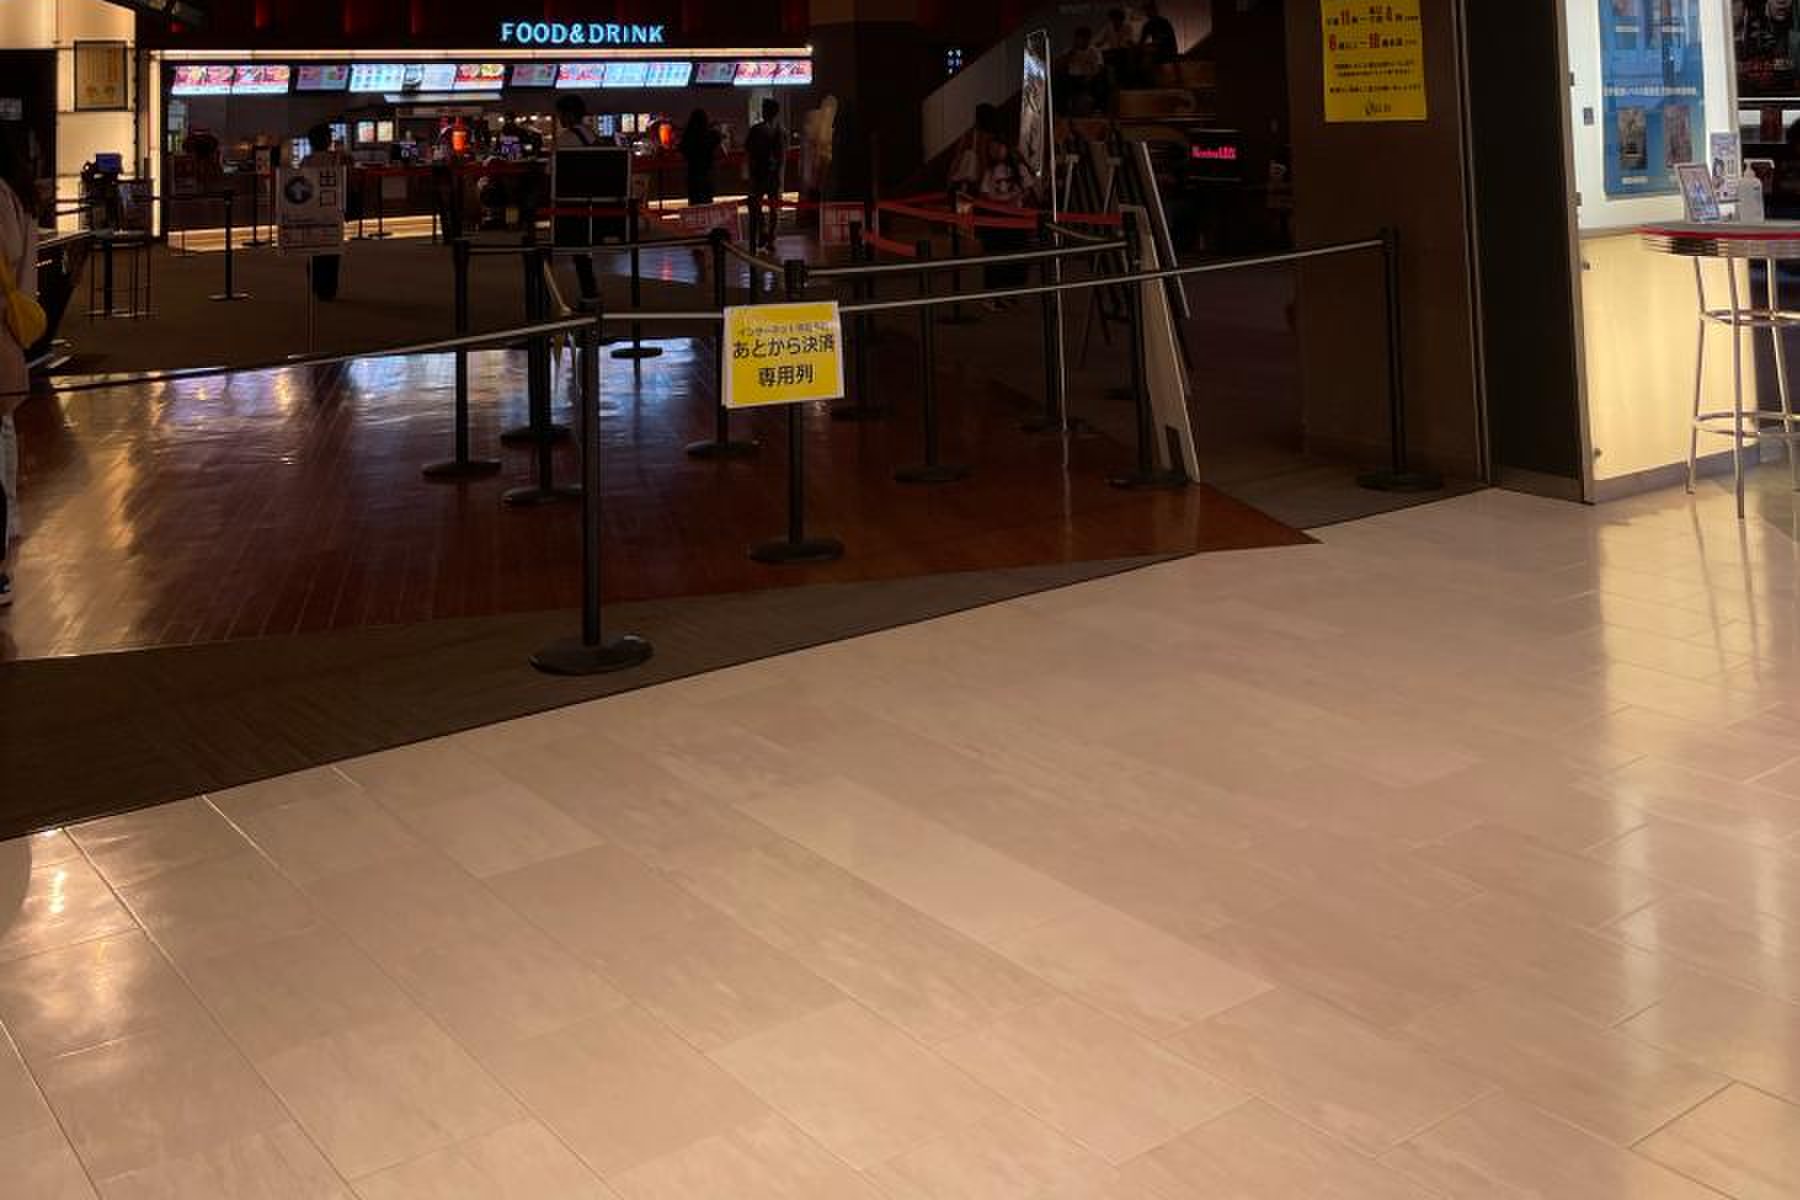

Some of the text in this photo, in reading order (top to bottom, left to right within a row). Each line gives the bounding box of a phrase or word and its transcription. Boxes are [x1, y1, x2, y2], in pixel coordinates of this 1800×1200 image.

[500, 22, 665, 44] FOOD&DRINK
[732, 334, 834, 359] あとから決済
[758, 364, 813, 387] 専用列
